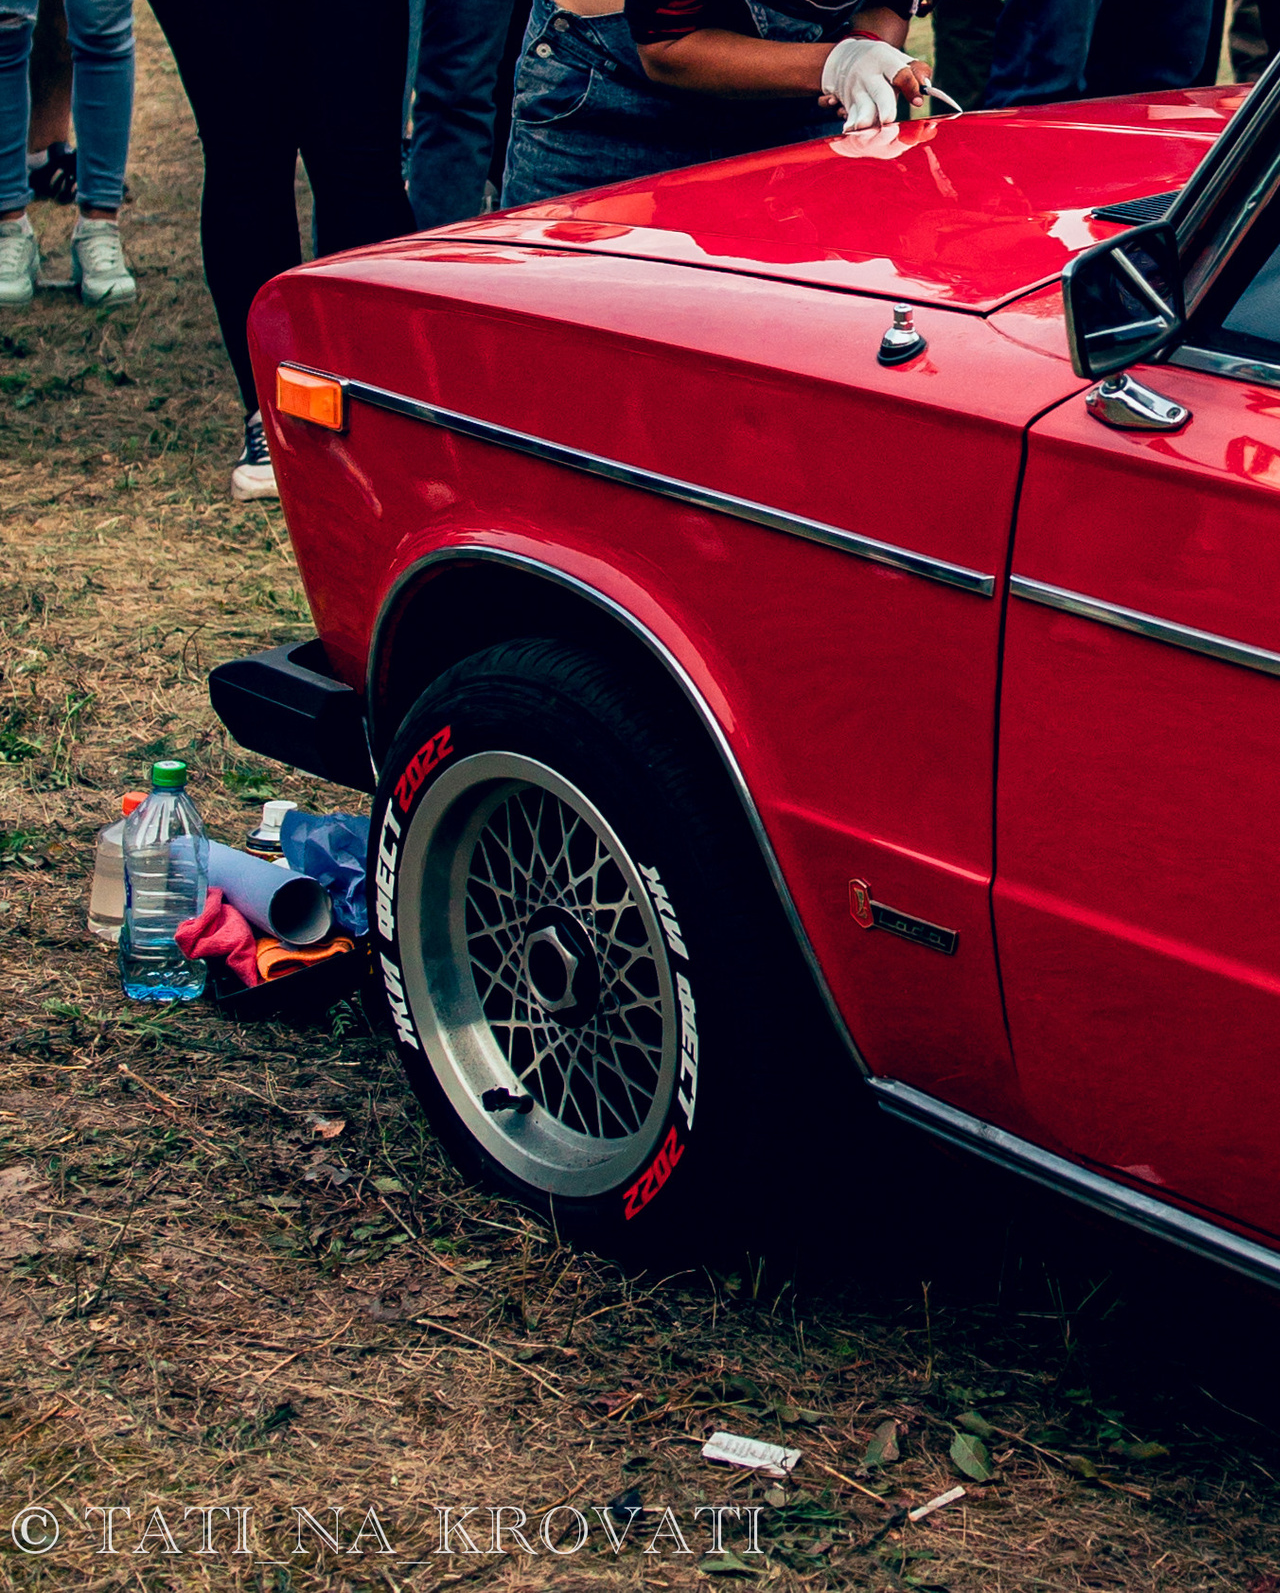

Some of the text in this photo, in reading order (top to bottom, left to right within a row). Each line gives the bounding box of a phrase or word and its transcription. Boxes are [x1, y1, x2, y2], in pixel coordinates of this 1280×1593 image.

[376, 724, 454, 1050] ЖИ ФЕСТ 2022
[622, 861, 699, 1221] ЖИ ФЕСТ 2022
[879, 910, 947, 947] Lada
